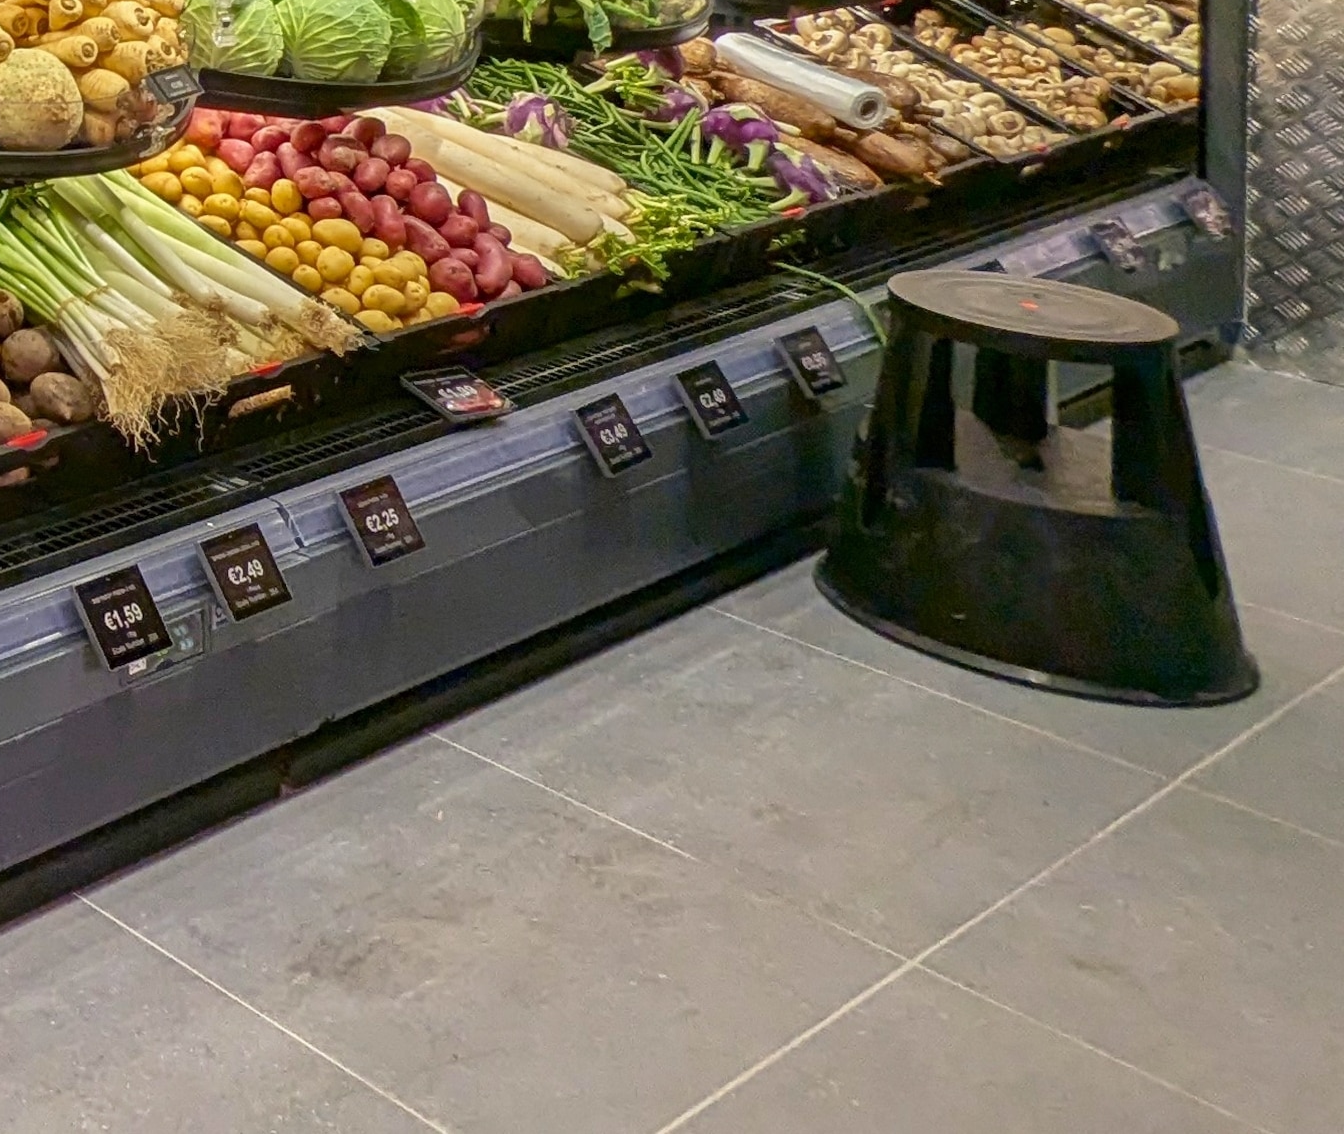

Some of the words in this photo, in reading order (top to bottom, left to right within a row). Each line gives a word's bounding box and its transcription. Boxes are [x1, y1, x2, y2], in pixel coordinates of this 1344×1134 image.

[366, 508, 399, 534] €2,25
[228, 559, 264, 586] €2,49
[104, 602, 144, 631] €1,59
